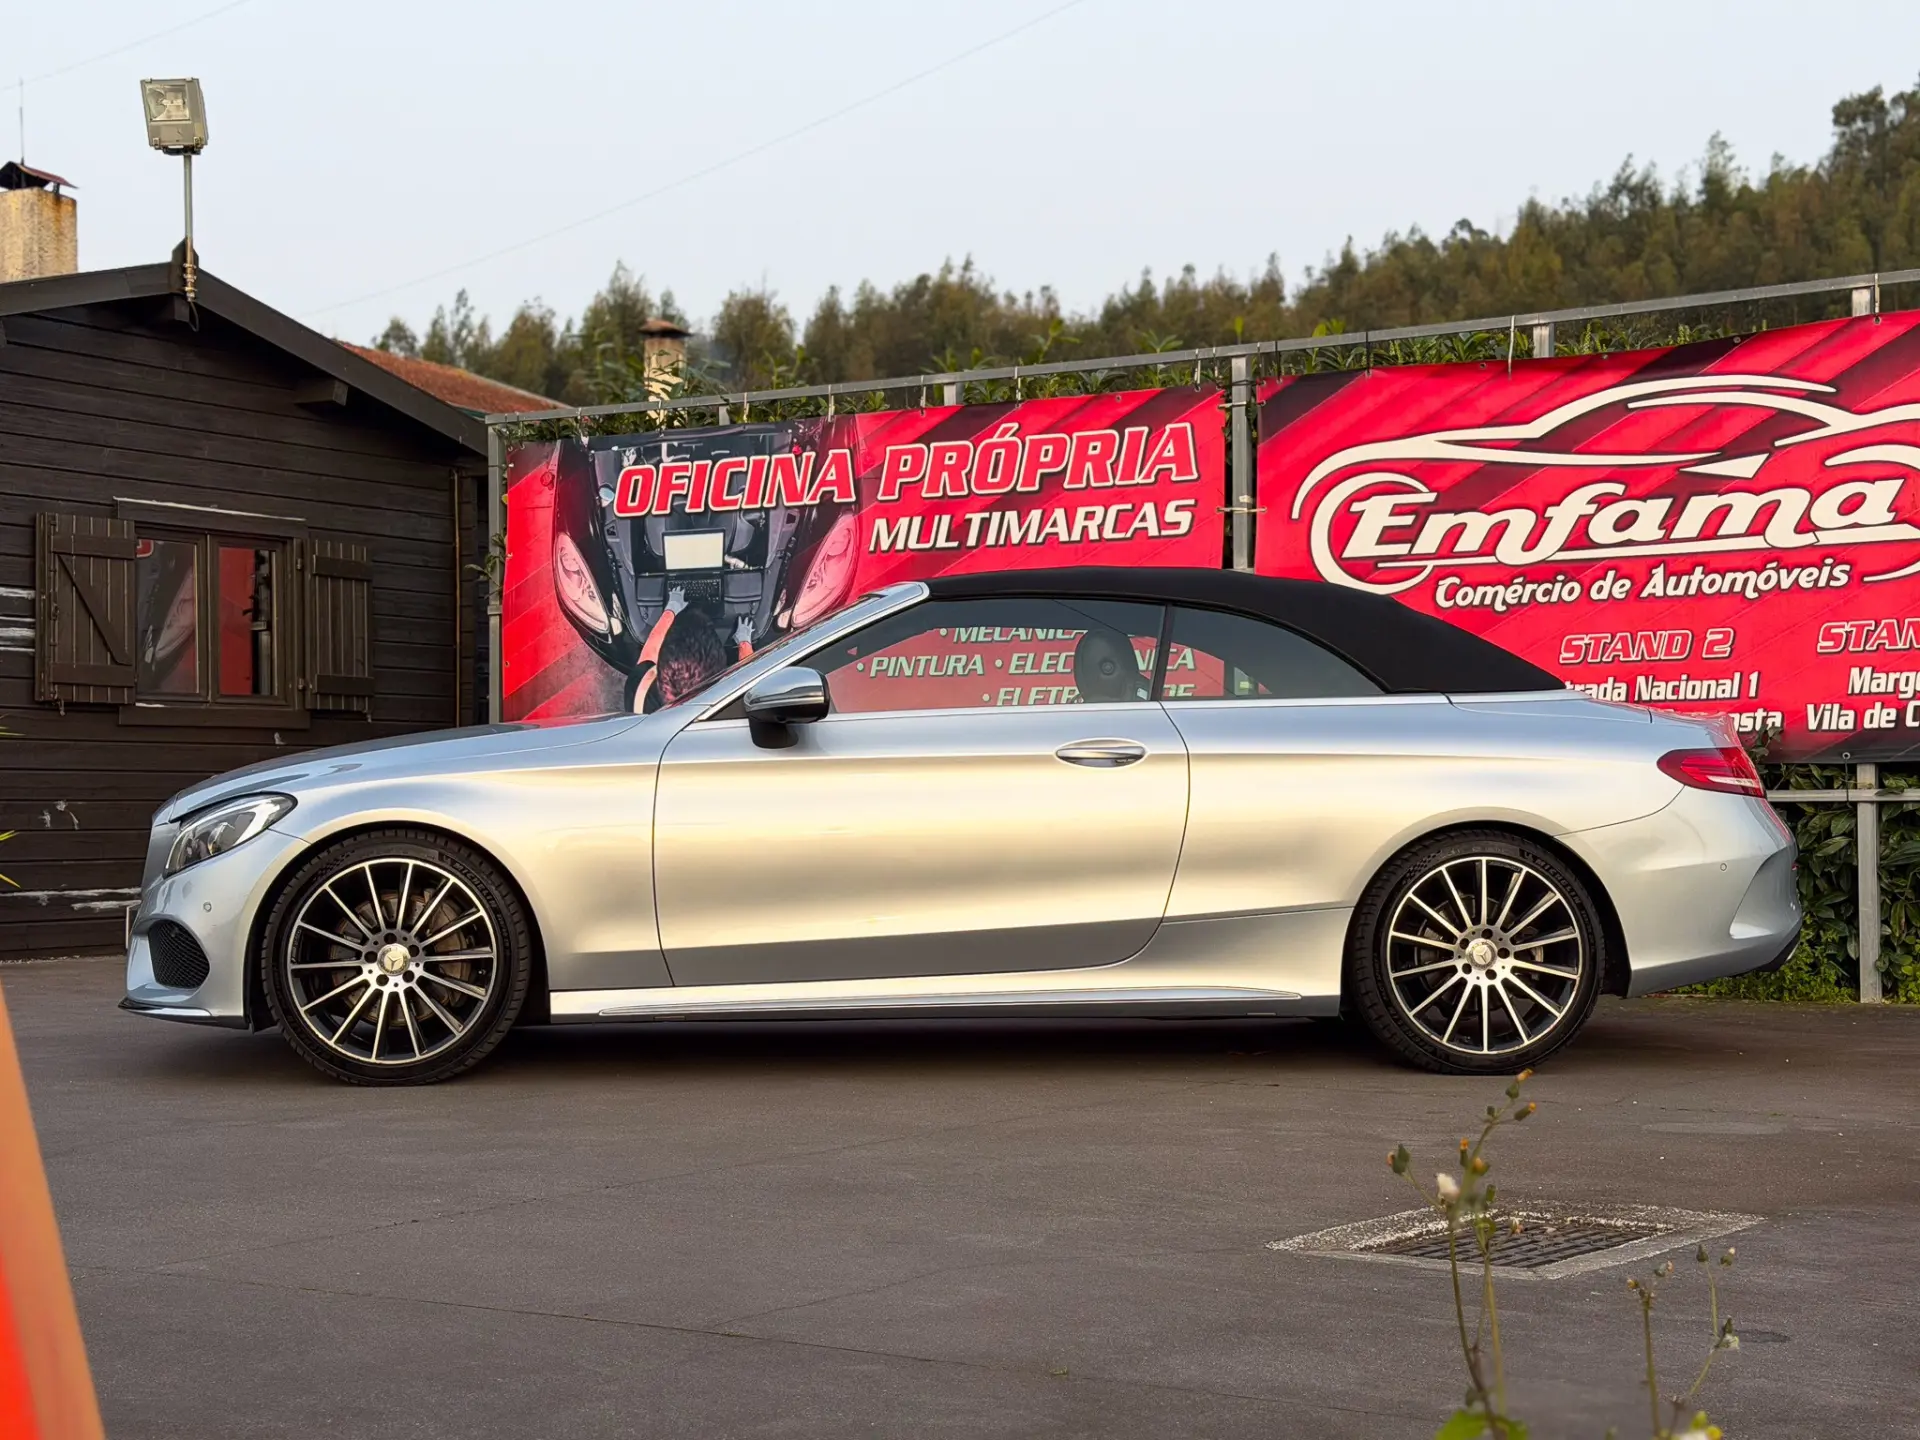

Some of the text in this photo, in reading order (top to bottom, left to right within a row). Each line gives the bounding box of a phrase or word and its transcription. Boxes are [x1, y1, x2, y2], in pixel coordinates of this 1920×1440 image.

[613, 422, 1199, 518] OFICINA PRÓPRIA
[869, 499, 1196, 552] MULTIMARCAS
[1341, 478, 1905, 566] Emfama
[1436, 558, 1850, 612] Comércio de Automóveis
[1559, 627, 1735, 664] STAND 2
[869, 654, 984, 678] PINTURA
[1847, 666, 1920, 699] Marg
[1634, 672, 1741, 702] Nacional
[1748, 671, 1761, 698] 1
[1806, 703, 1856, 731] Vila
[1863, 701, 1897, 730] de
